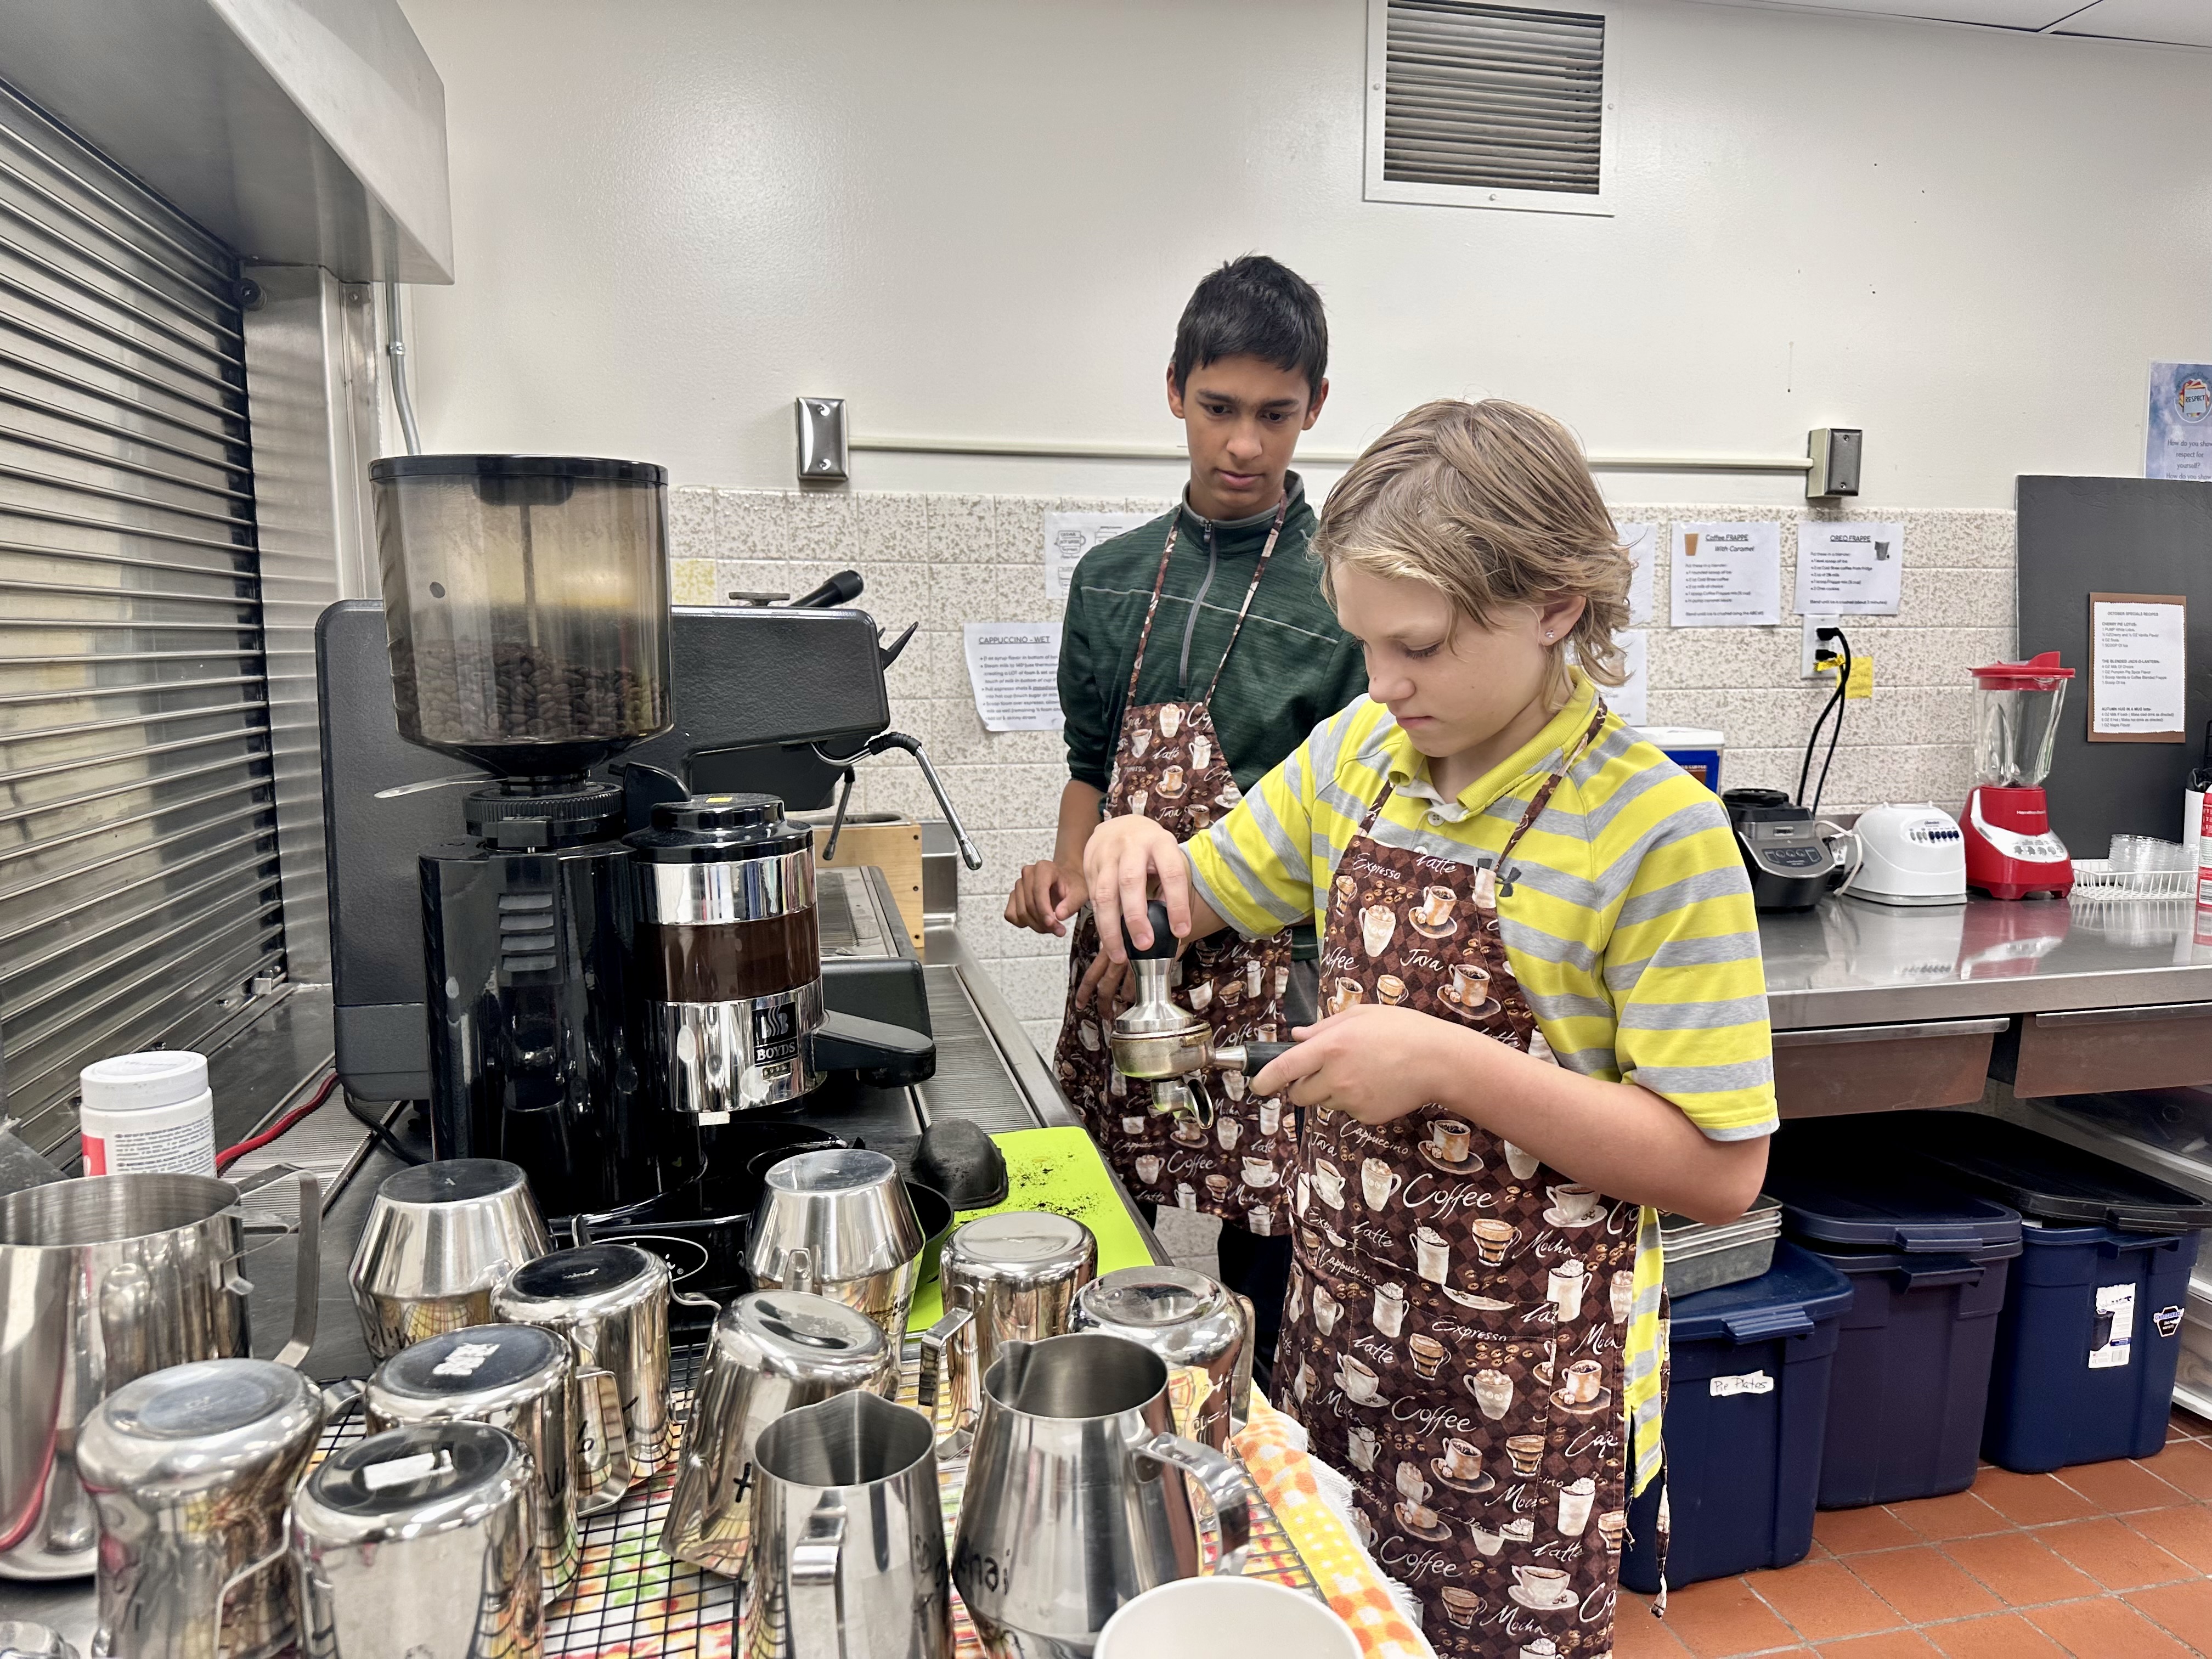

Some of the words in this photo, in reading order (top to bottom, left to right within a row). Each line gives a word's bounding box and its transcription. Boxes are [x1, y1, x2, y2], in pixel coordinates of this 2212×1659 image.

[2185, 394, 2205, 403] RESPECT
[2177, 462, 2200, 470] yourself?
[1155, 806, 1183, 821] Java
[1353, 853, 1401, 879] Expresso
[1417, 854, 1457, 873] Latte
[1322, 946, 1359, 977] offee
[1400, 949, 1443, 972] Java
[757, 1041, 795, 1061] BOYDS
[1310, 1132, 1337, 1157] Java
[1340, 1119, 1408, 1155] Cappuccino
[1167, 1150, 1218, 1178] Coffee
[1228, 1184, 1265, 1206] Mocha
[1403, 1173, 1499, 1218] Coffee
[1351, 1221, 1395, 1248] Latte
[1512, 1231, 1578, 1259] Mocha
[1318, 1248, 1376, 1284] Cappuccino
[1352, 1335, 1395, 1364] Latte
[1714, 1380, 1728, 1392] Pie
[1317, 1390, 1367, 1426] Mocha
[1391, 1395, 1477, 1437] Coffee
[1380, 1536, 1463, 1579] Coffee
[1479, 1605, 1550, 1637] Mocha
